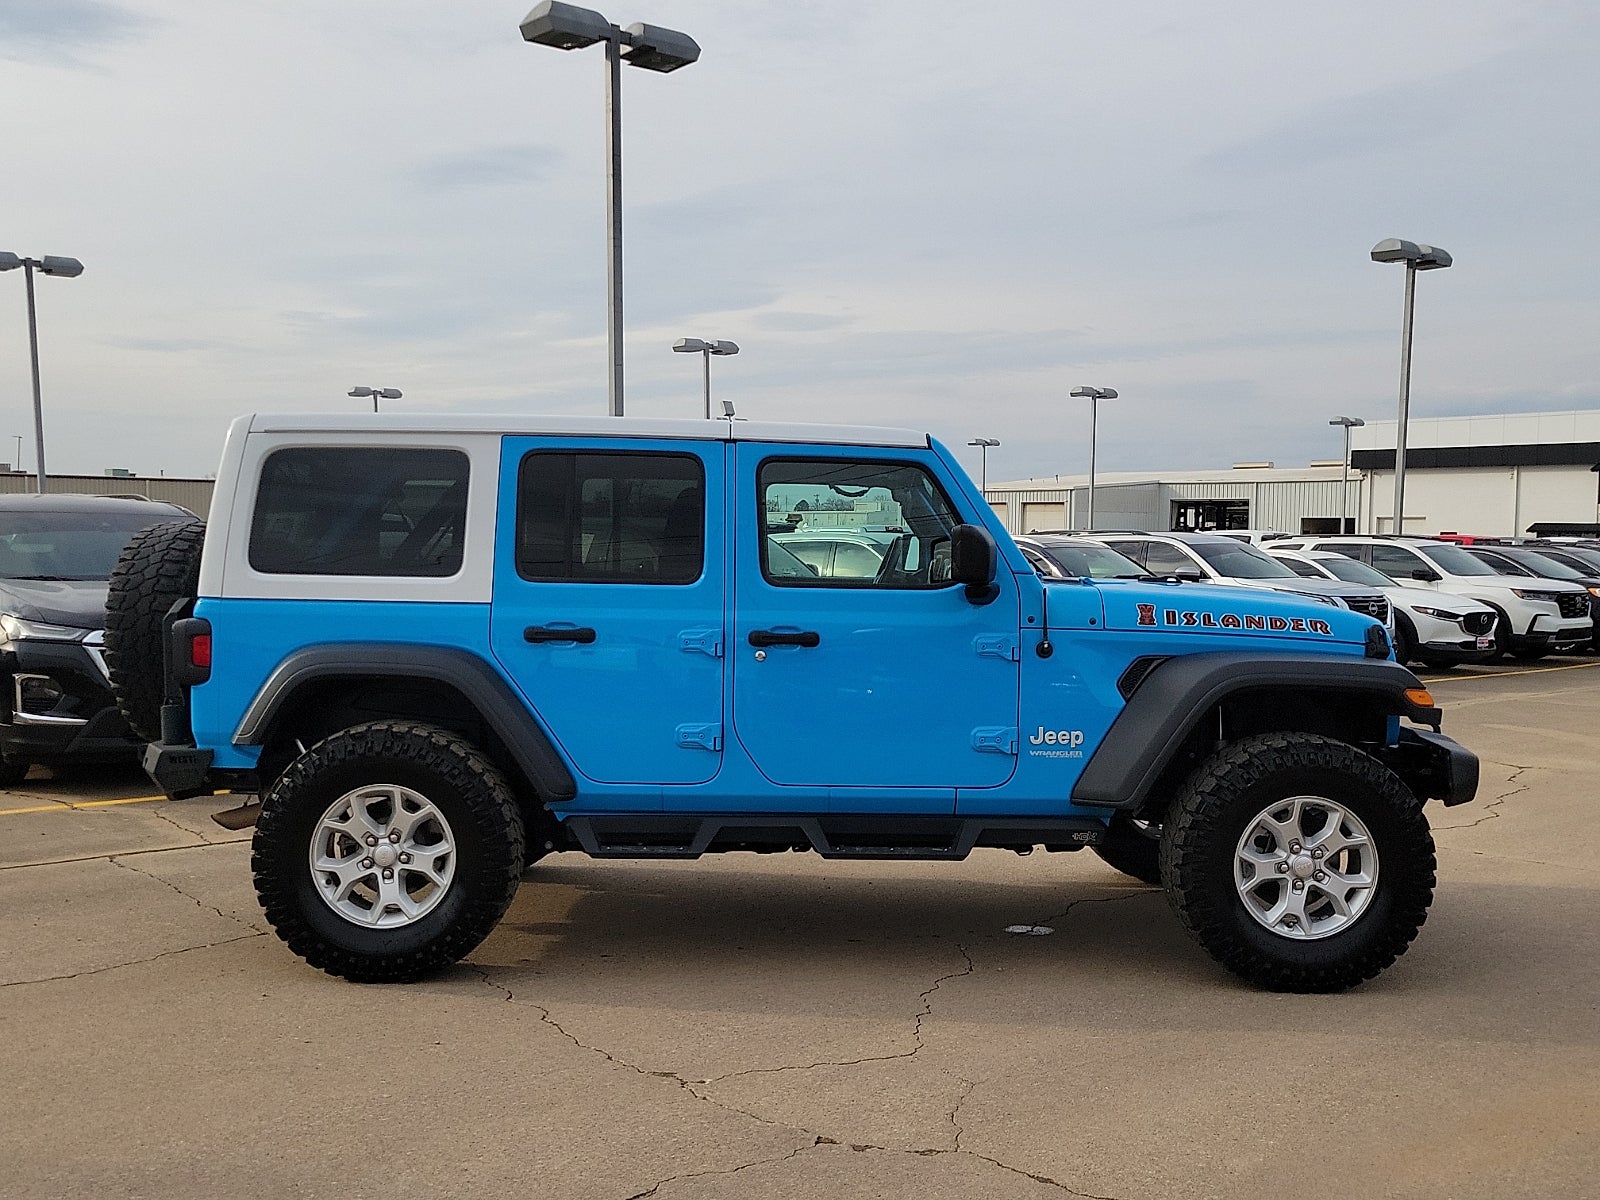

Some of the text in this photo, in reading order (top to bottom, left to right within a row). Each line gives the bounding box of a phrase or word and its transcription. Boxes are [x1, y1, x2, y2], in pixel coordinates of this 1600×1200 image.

[1164, 609, 1334, 636] ISLANDER
[1029, 726, 1084, 748] Jeep
[1029, 750, 1083, 758] WRANGLER
